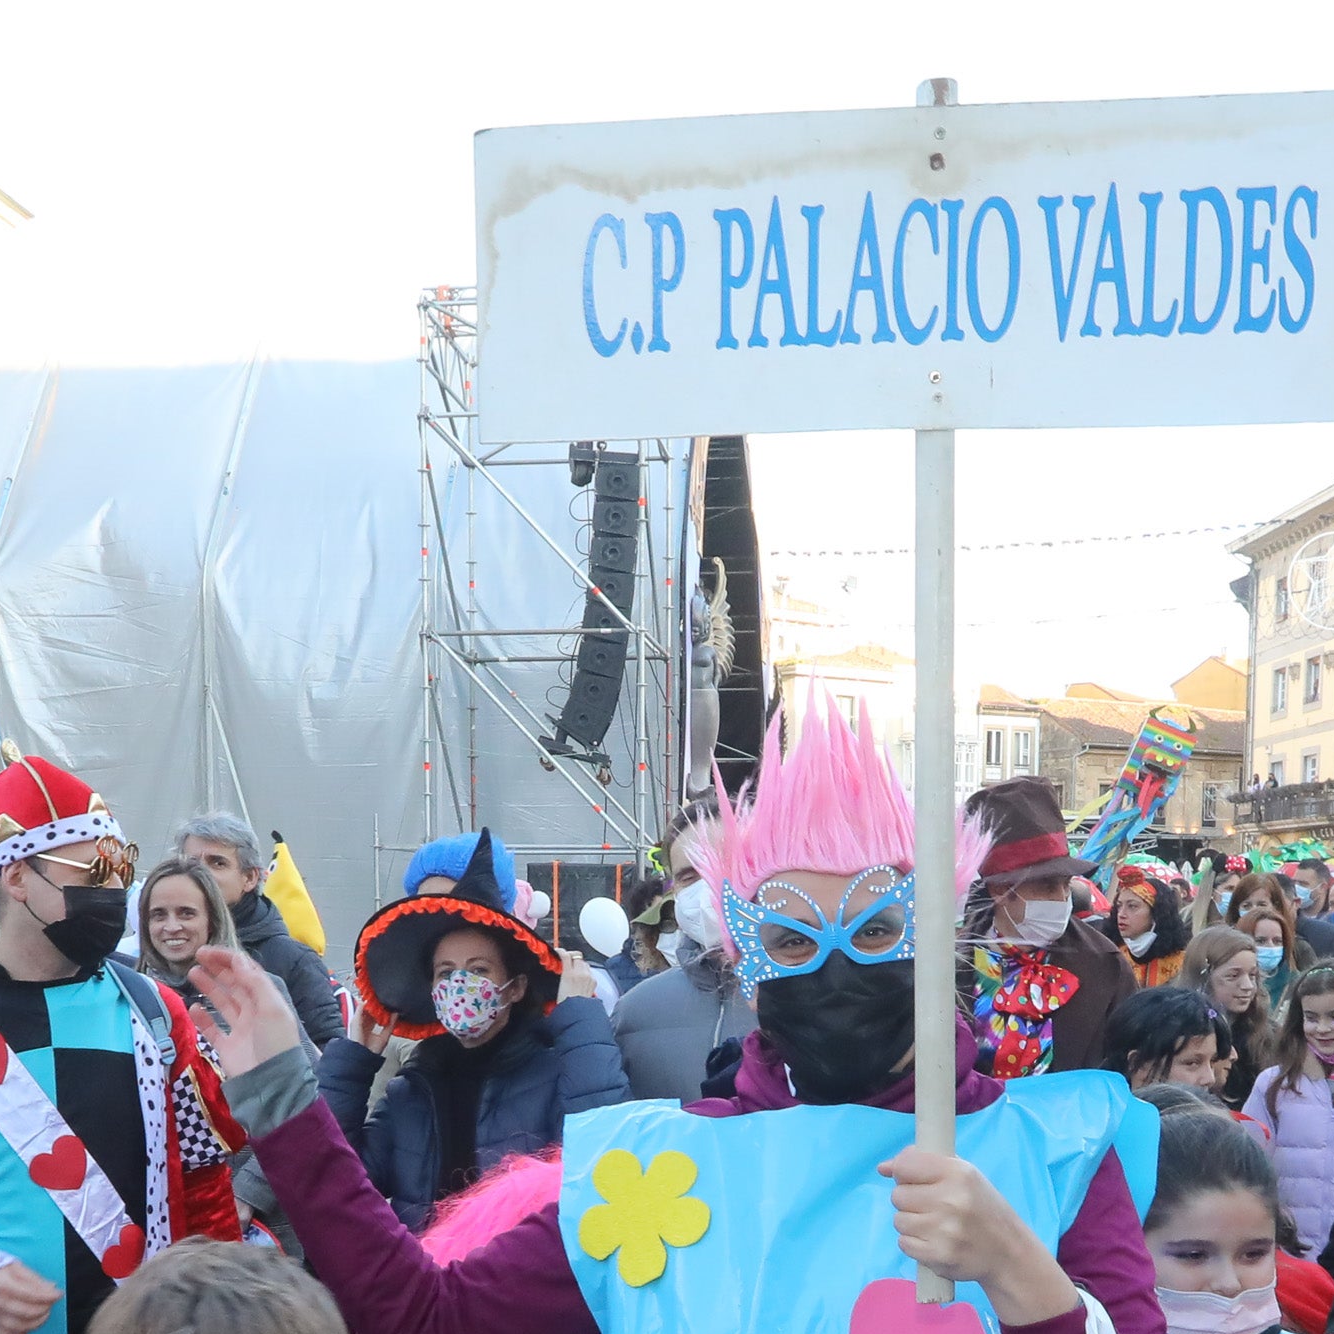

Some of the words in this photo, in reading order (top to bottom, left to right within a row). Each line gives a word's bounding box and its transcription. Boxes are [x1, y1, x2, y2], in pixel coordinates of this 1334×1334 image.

[581, 211, 686, 357] C.P
[713, 191, 1021, 349] PALACIO
[1039, 181, 1318, 342] VALDES
